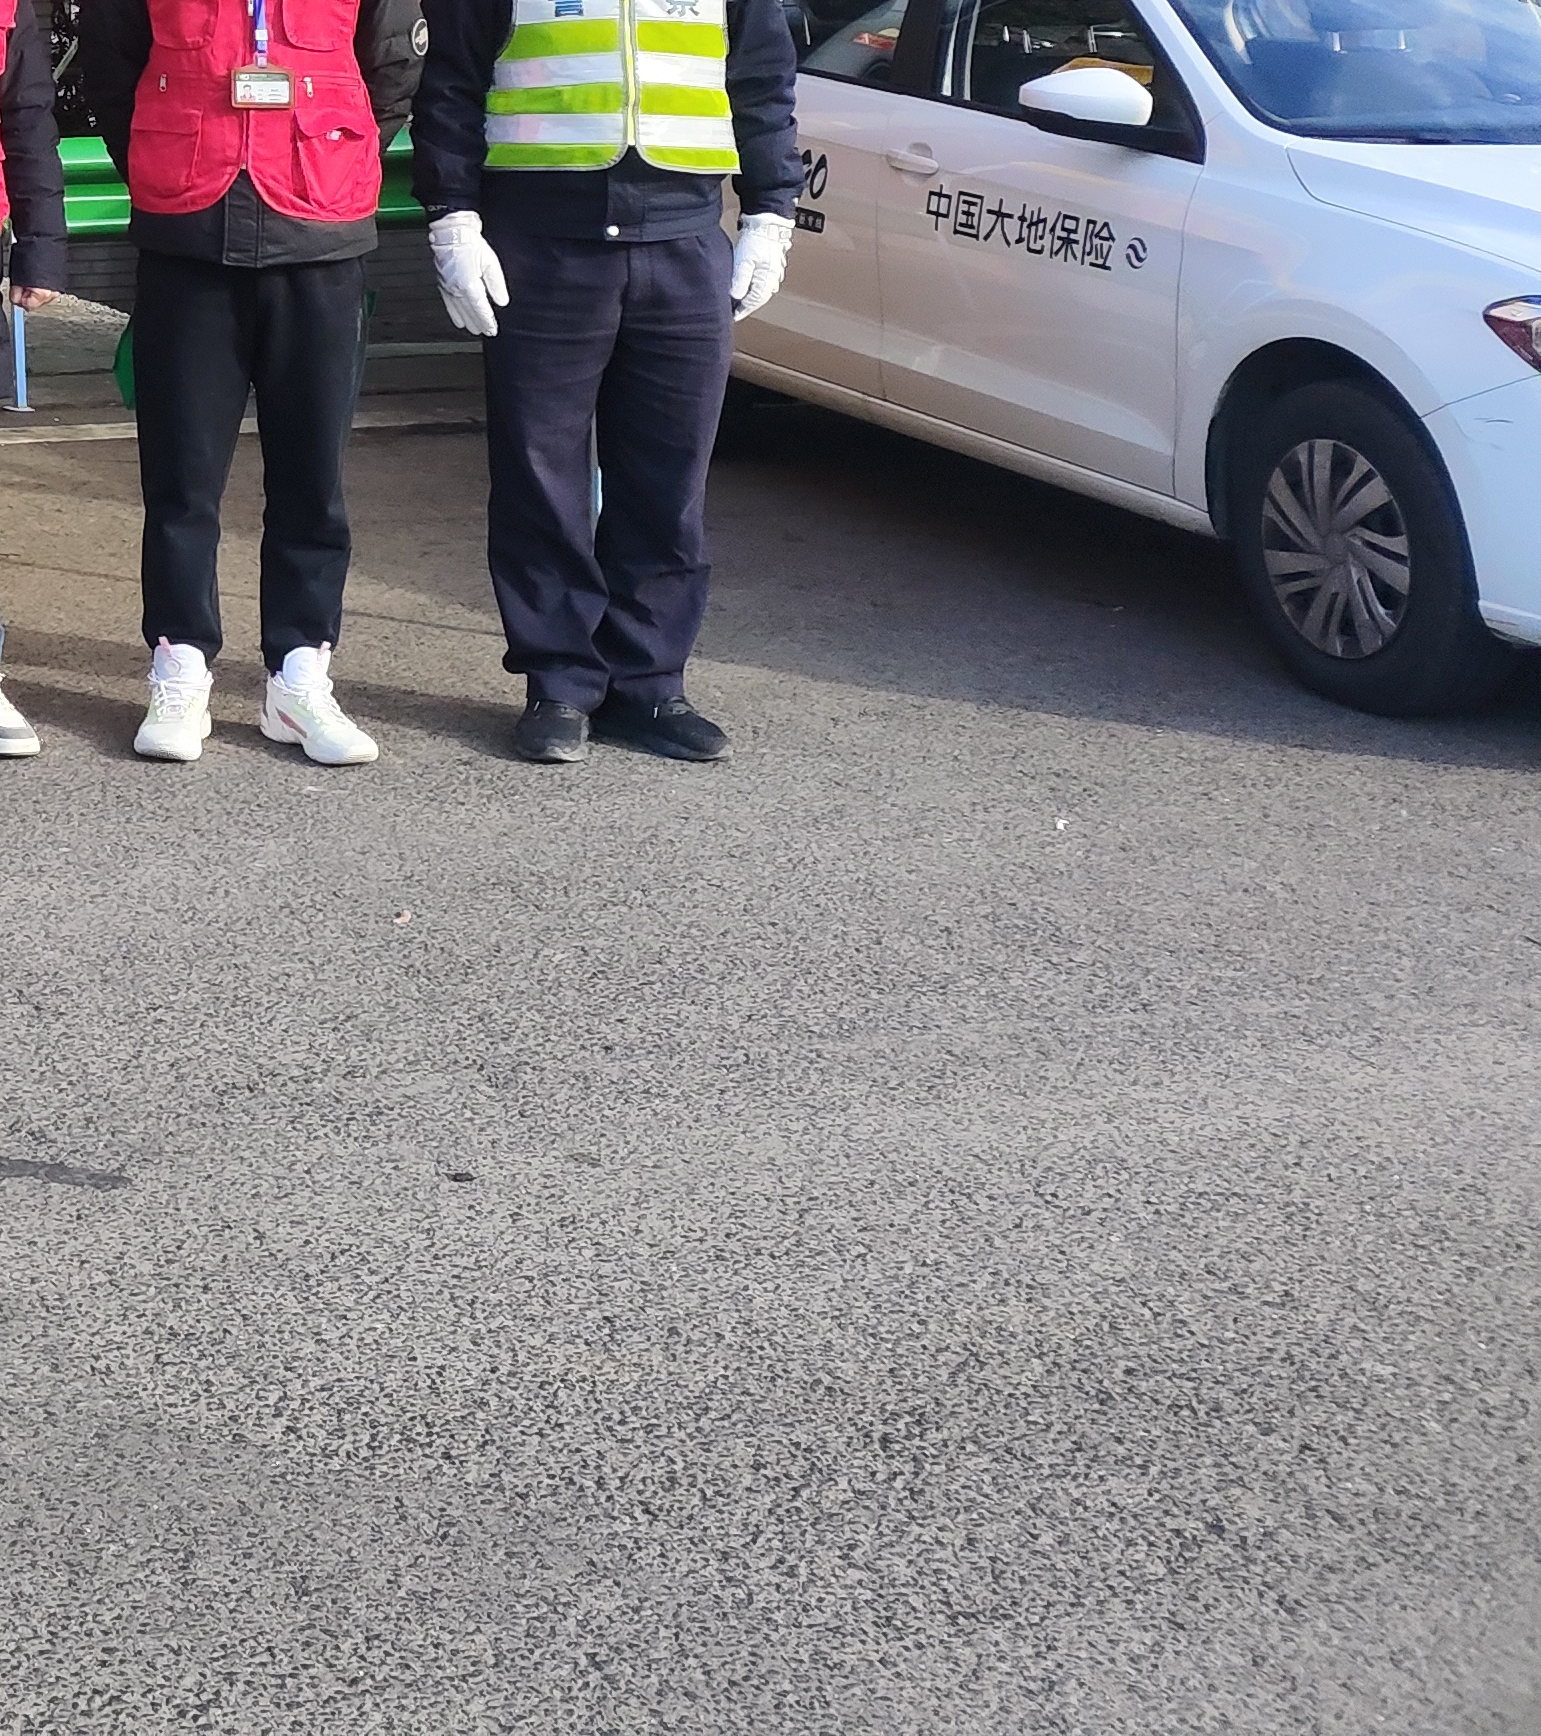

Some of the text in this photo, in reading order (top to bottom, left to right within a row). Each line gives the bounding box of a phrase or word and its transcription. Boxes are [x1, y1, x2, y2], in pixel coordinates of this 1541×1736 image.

[926, 184, 1116, 271] 中国大地保险
